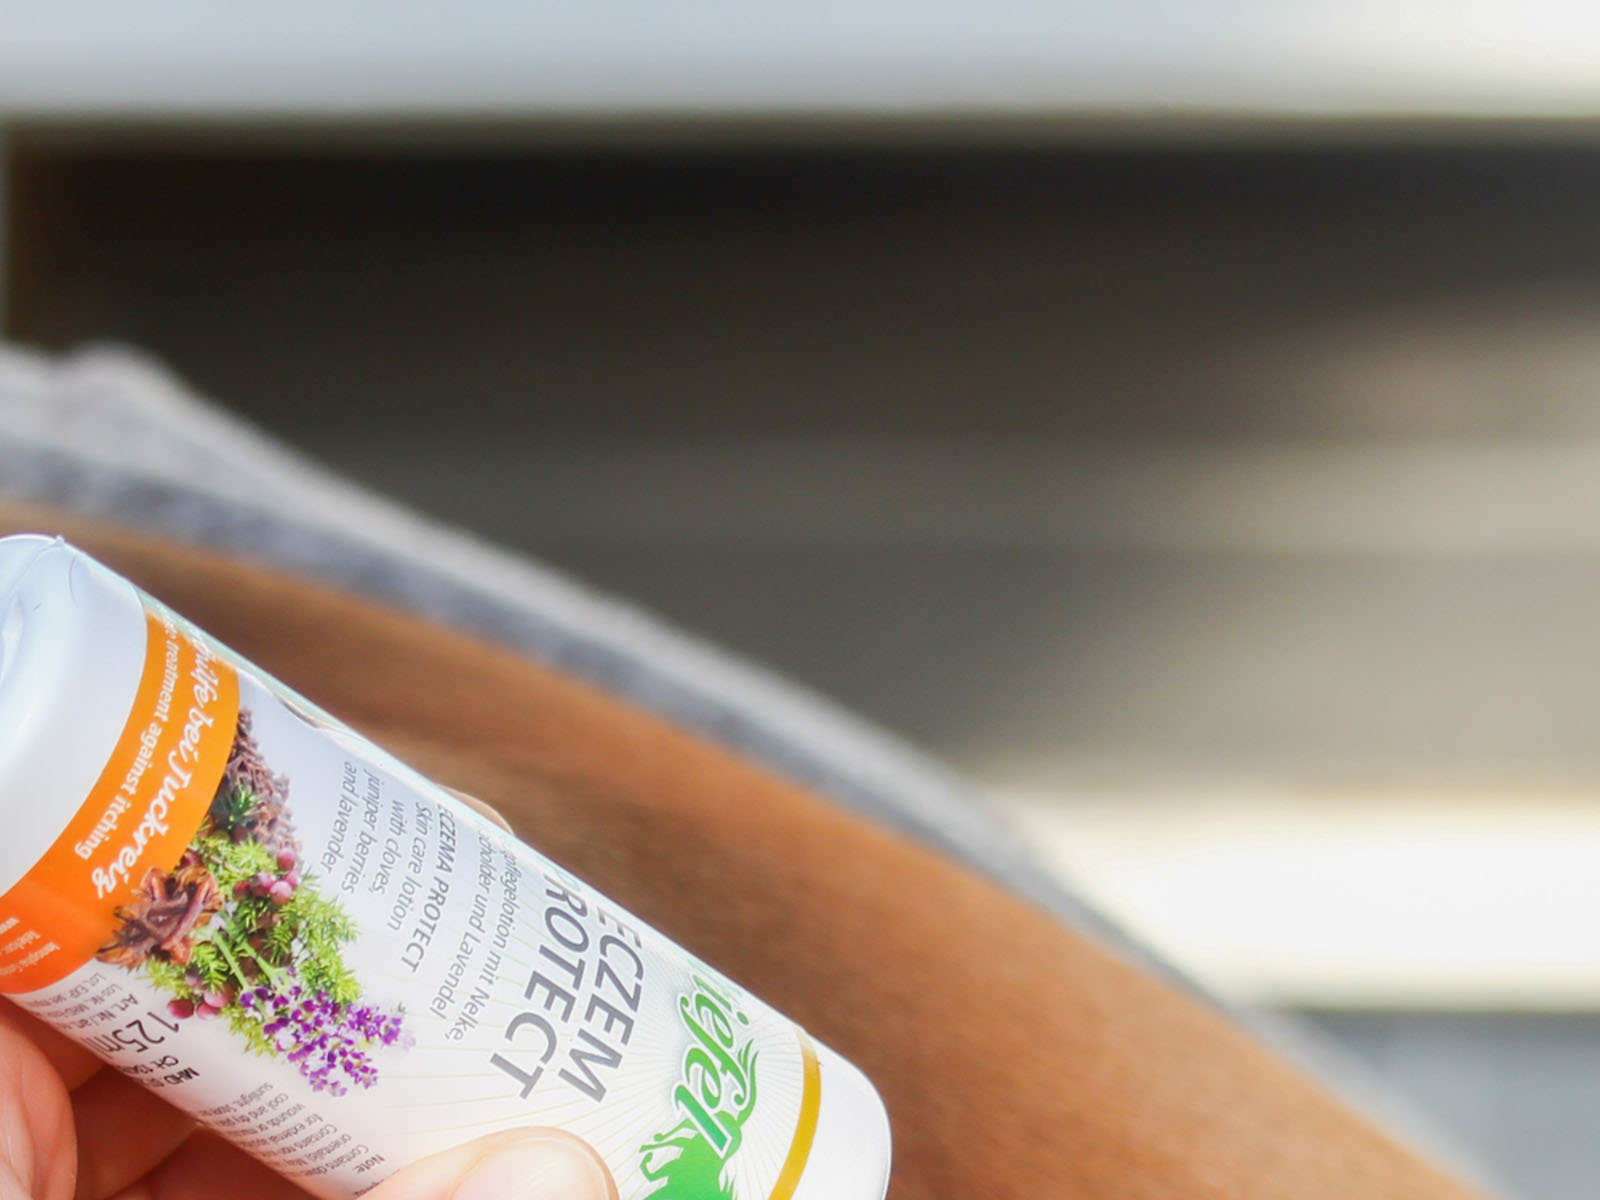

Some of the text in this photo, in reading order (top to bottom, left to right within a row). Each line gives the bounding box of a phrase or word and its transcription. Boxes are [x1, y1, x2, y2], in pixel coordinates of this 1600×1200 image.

[153, 639, 180, 722] treatment
[120, 724, 162, 796] against
[178, 706, 215, 763] bei
[73, 793, 133, 860] itching
[91, 747, 193, 900] Juckreiz
[320, 760, 359, 875] and lavender
[341, 768, 385, 894] juniper berries
[368, 799, 407, 895] with cloves,
[386, 801, 433, 931] Skin care lotion
[401, 874, 450, 974] PROTECT
[468, 893, 489, 934] und
[429, 931, 481, 1020] Lavendel
[445, 985, 490, 1042] Nelke,
[481, 950, 502, 987] mit
[489, 874, 589, 1100] ROTECT
[675, 974, 750, 1151] iefel
